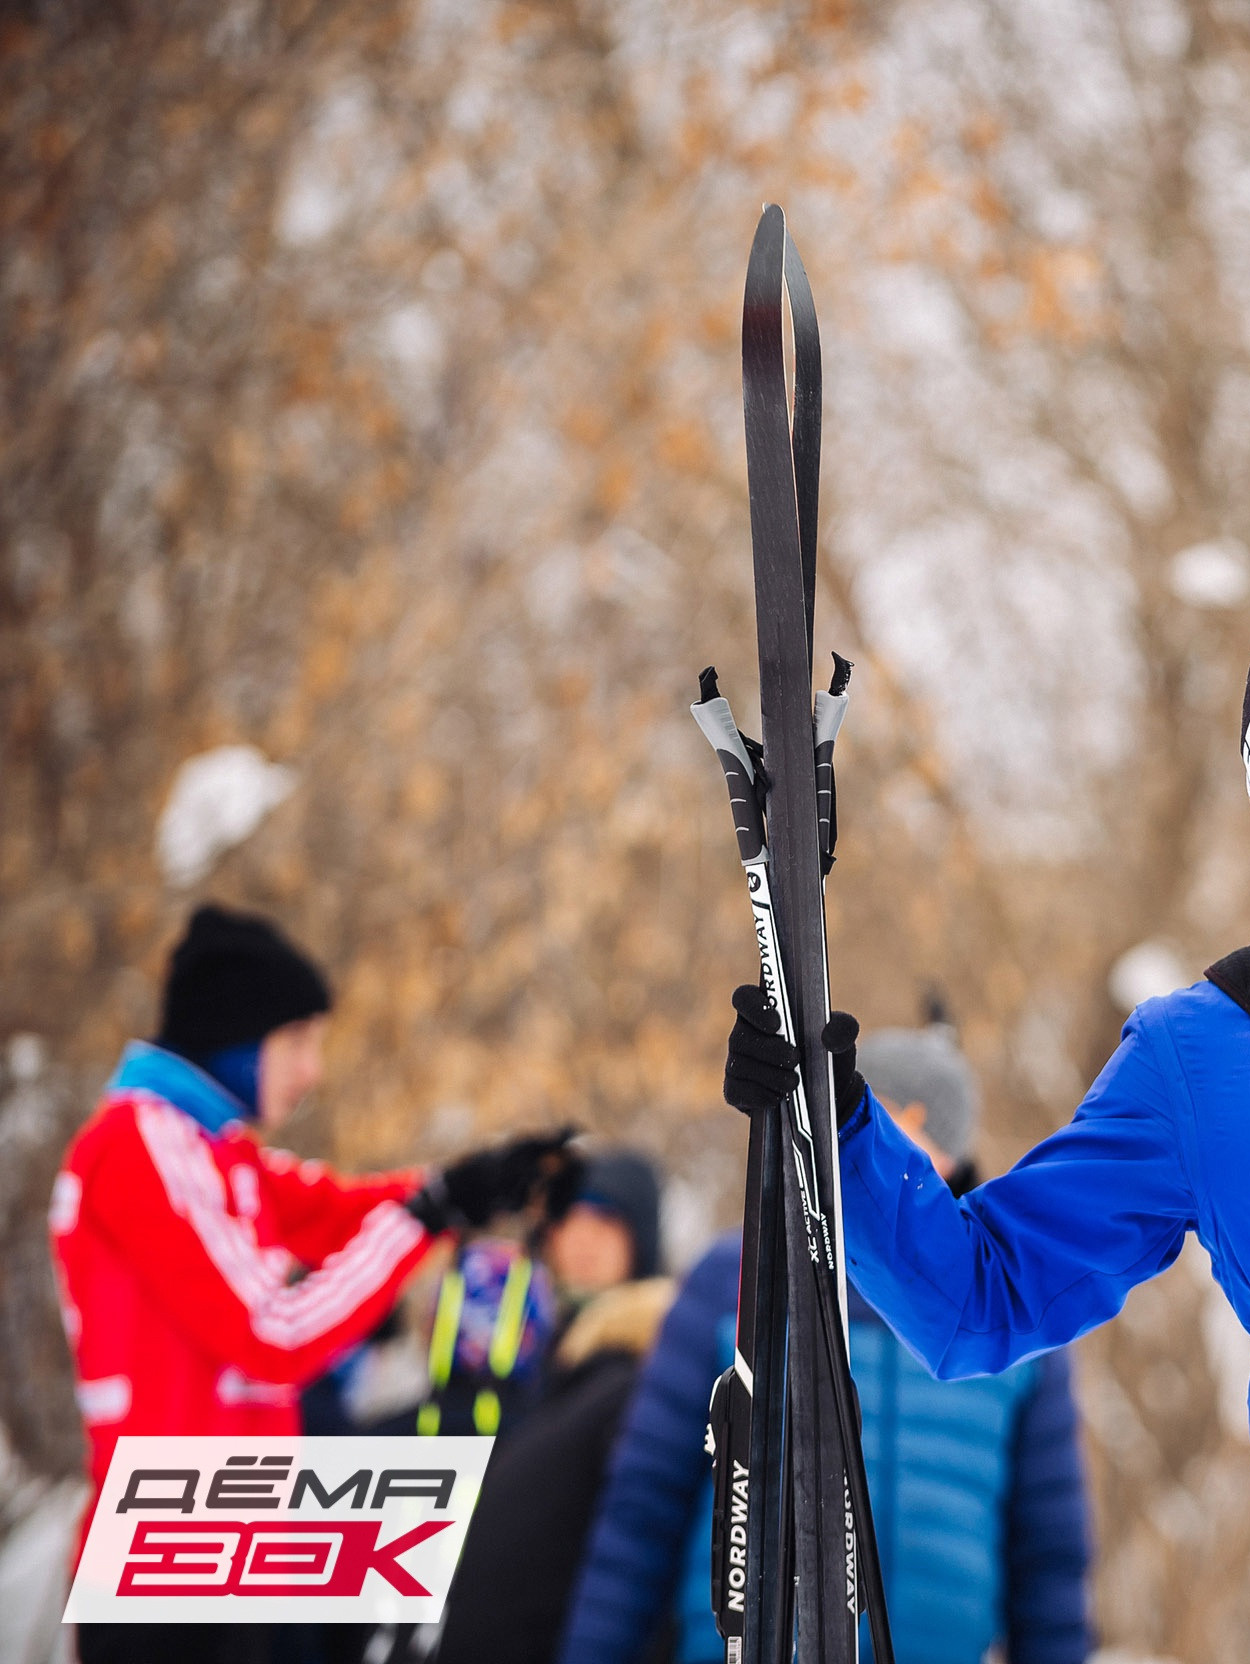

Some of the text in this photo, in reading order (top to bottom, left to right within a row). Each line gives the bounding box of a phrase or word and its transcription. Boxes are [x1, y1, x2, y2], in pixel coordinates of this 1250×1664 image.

[754, 912, 778, 1010] ORDWAY
[820, 1212, 835, 1270] NORDWAY
[728, 1459, 750, 1613] NORDWAY
